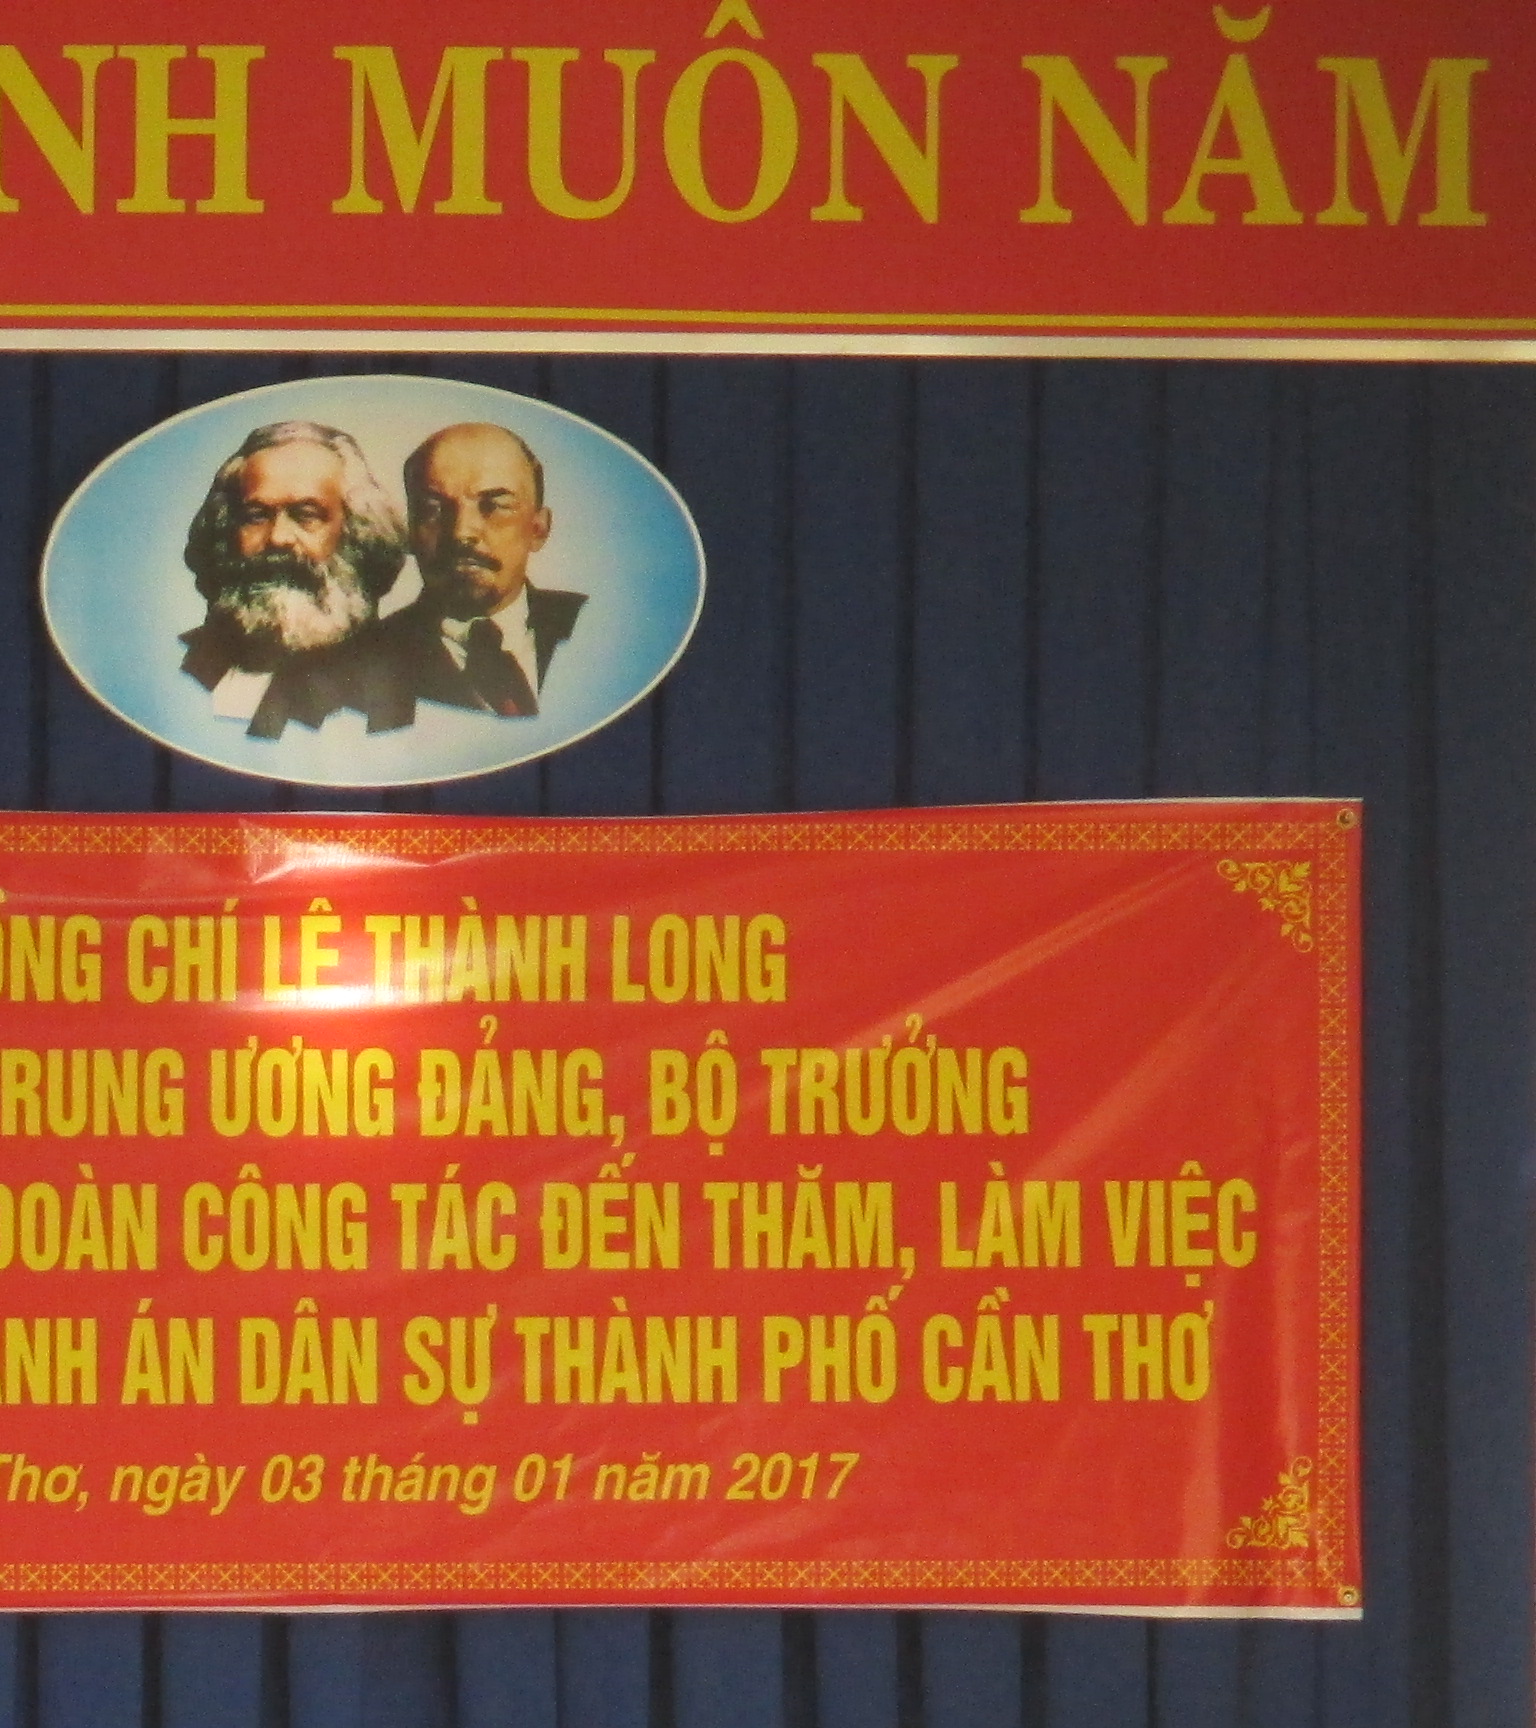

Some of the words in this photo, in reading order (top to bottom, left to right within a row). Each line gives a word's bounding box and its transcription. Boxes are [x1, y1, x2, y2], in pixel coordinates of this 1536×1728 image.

[332, 0, 959, 223] MUÔN
[1020, 5, 1487, 226] NĂM
[125, 898, 240, 1003] CHÍ
[264, 897, 342, 1002] LÊ
[362, 897, 588, 1004] THÀNH
[610, 913, 789, 1004] LONG
[208, 1035, 399, 1139] ƯƠNG
[414, 1014, 626, 1147] ĐẢNG,
[648, 1030, 740, 1158] BỘ
[759, 1013, 1030, 1136] TRƯỞNG
[181, 1163, 370, 1273] CÔNG
[389, 1163, 519, 1272] TÁC
[537, 1153, 683, 1271] ĐẾN
[701, 1163, 917, 1285] THĂM,
[938, 1162, 1083, 1270] LÀM
[1104, 1160, 1258, 1288] VIỆC
[120, 1299, 216, 1406] ÁN
[237, 1297, 381, 1405] DÂN
[401, 1304, 500, 1425] SỰ
[512, 1296, 741, 1405] THÀNH
[761, 1284, 904, 1404] PHỐ
[921, 1287, 1062, 1404] CẦN
[1080, 1300, 1216, 1403] THƠ
[110, 1454, 245, 1516] ngày
[260, 1454, 327, 1503] 03
[341, 1452, 499, 1516] tháng
[512, 1454, 574, 1502] 01
[593, 1453, 713, 1502] năm
[724, 1452, 860, 1502] 2017
